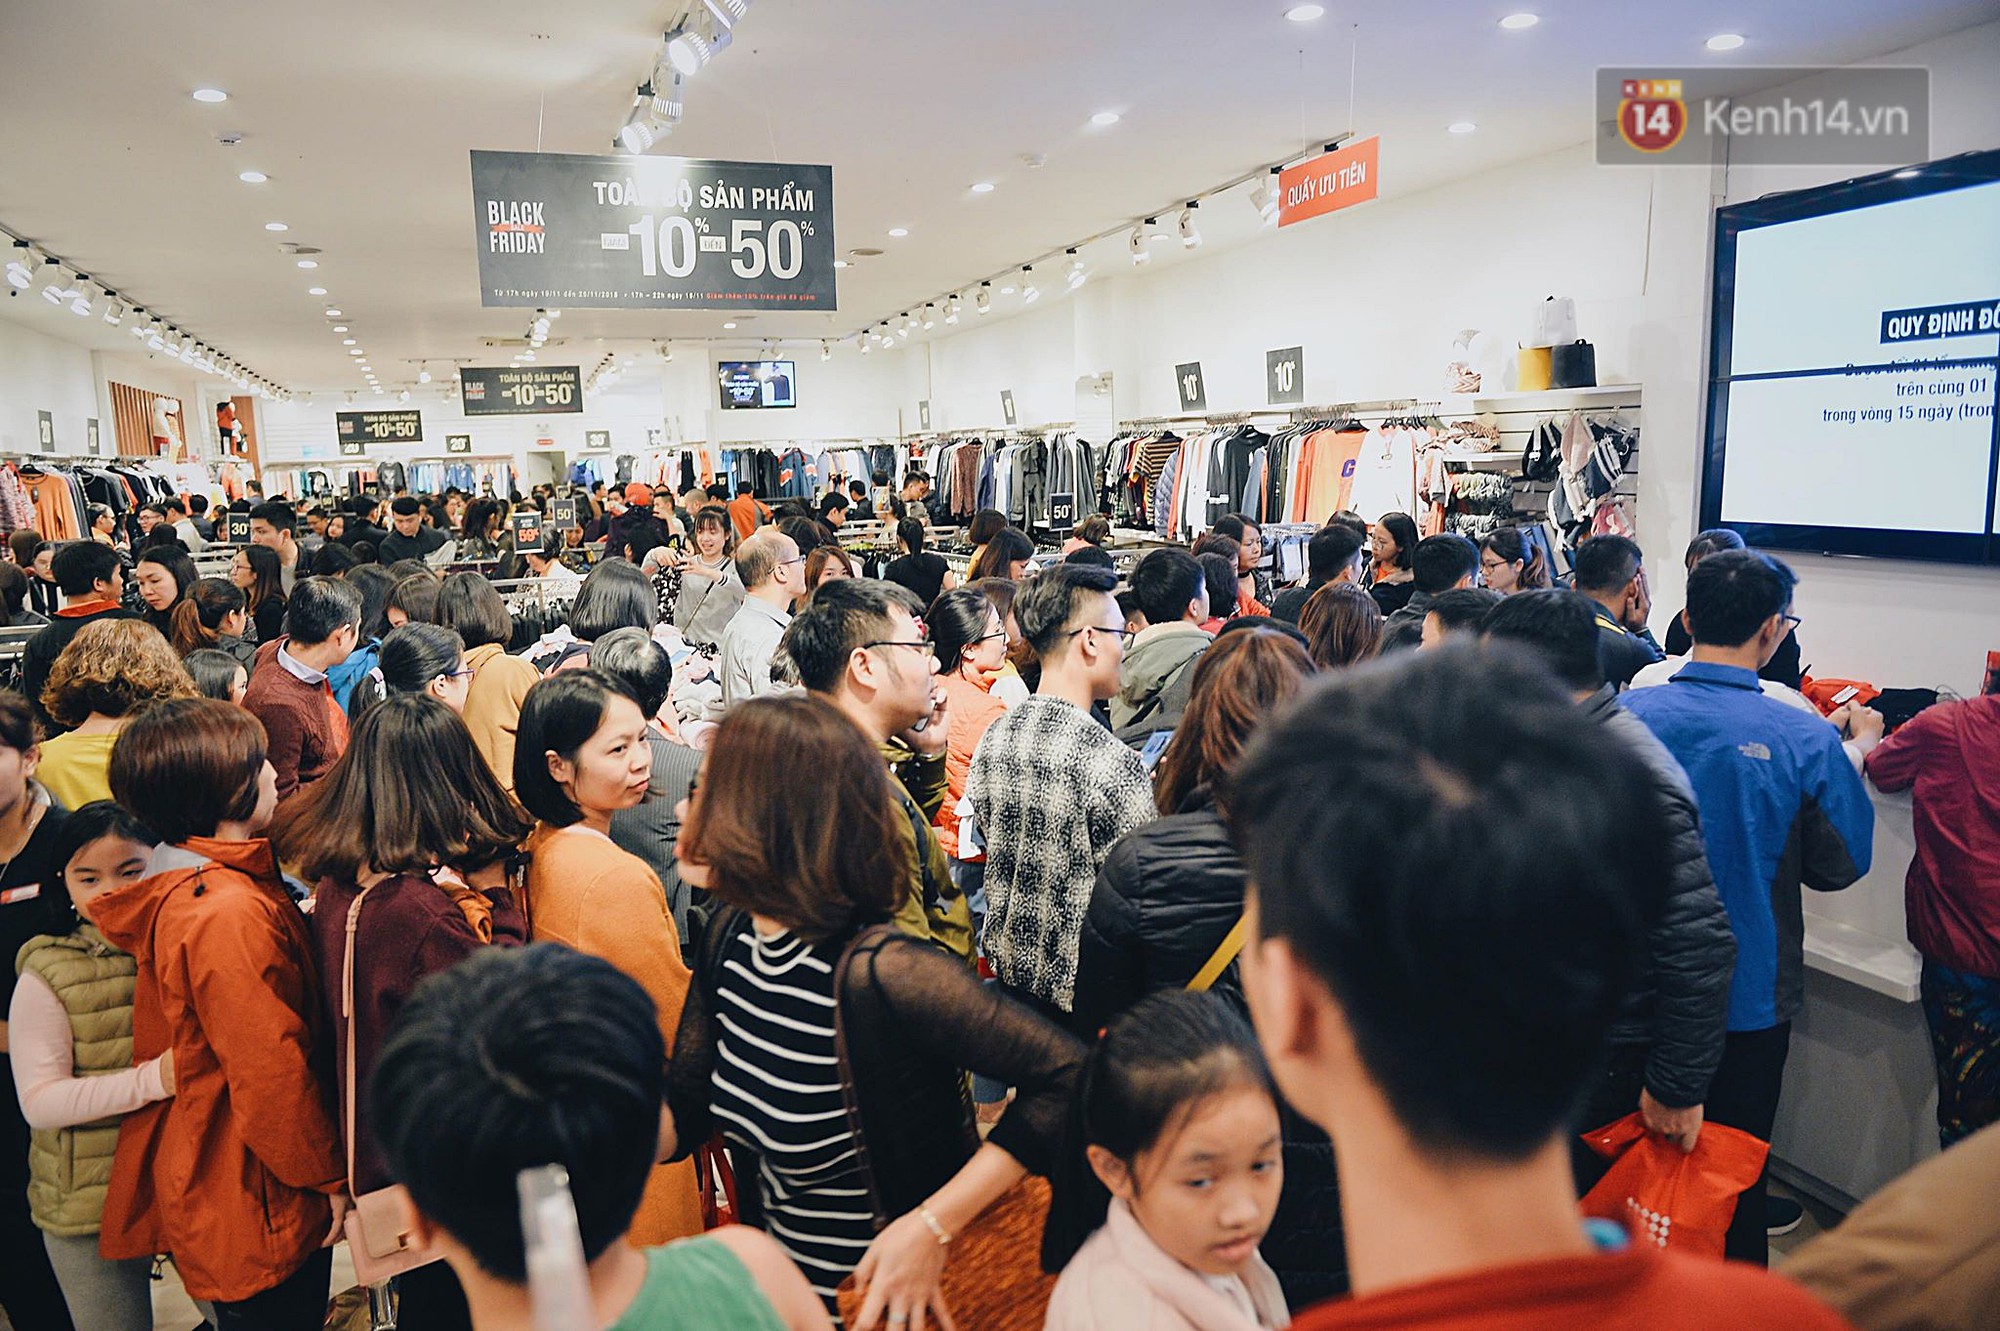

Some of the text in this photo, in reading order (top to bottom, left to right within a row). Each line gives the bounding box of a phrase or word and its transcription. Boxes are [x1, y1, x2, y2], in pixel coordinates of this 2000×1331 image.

[1319, 172, 1337, 197] ƯU
[1339, 161, 1366, 190] TIÊN
[700, 180, 745, 209] SẢN
[752, 181, 815, 211] PHẨM
[488, 200, 546, 226] BLACK
[490, 231, 546, 254] FRIDAY
[1888, 315, 1925, 340] QUY
[1928, 309, 1974, 339] ĐỊNH
[1896, 381, 1924, 397] trên
[1969, 378, 1987, 394] 01
[1823, 408, 1856, 424] trong
[1860, 405, 1892, 423] vòng
[1898, 405, 1914, 420] 15
[1918, 403, 1953, 422] ngày
